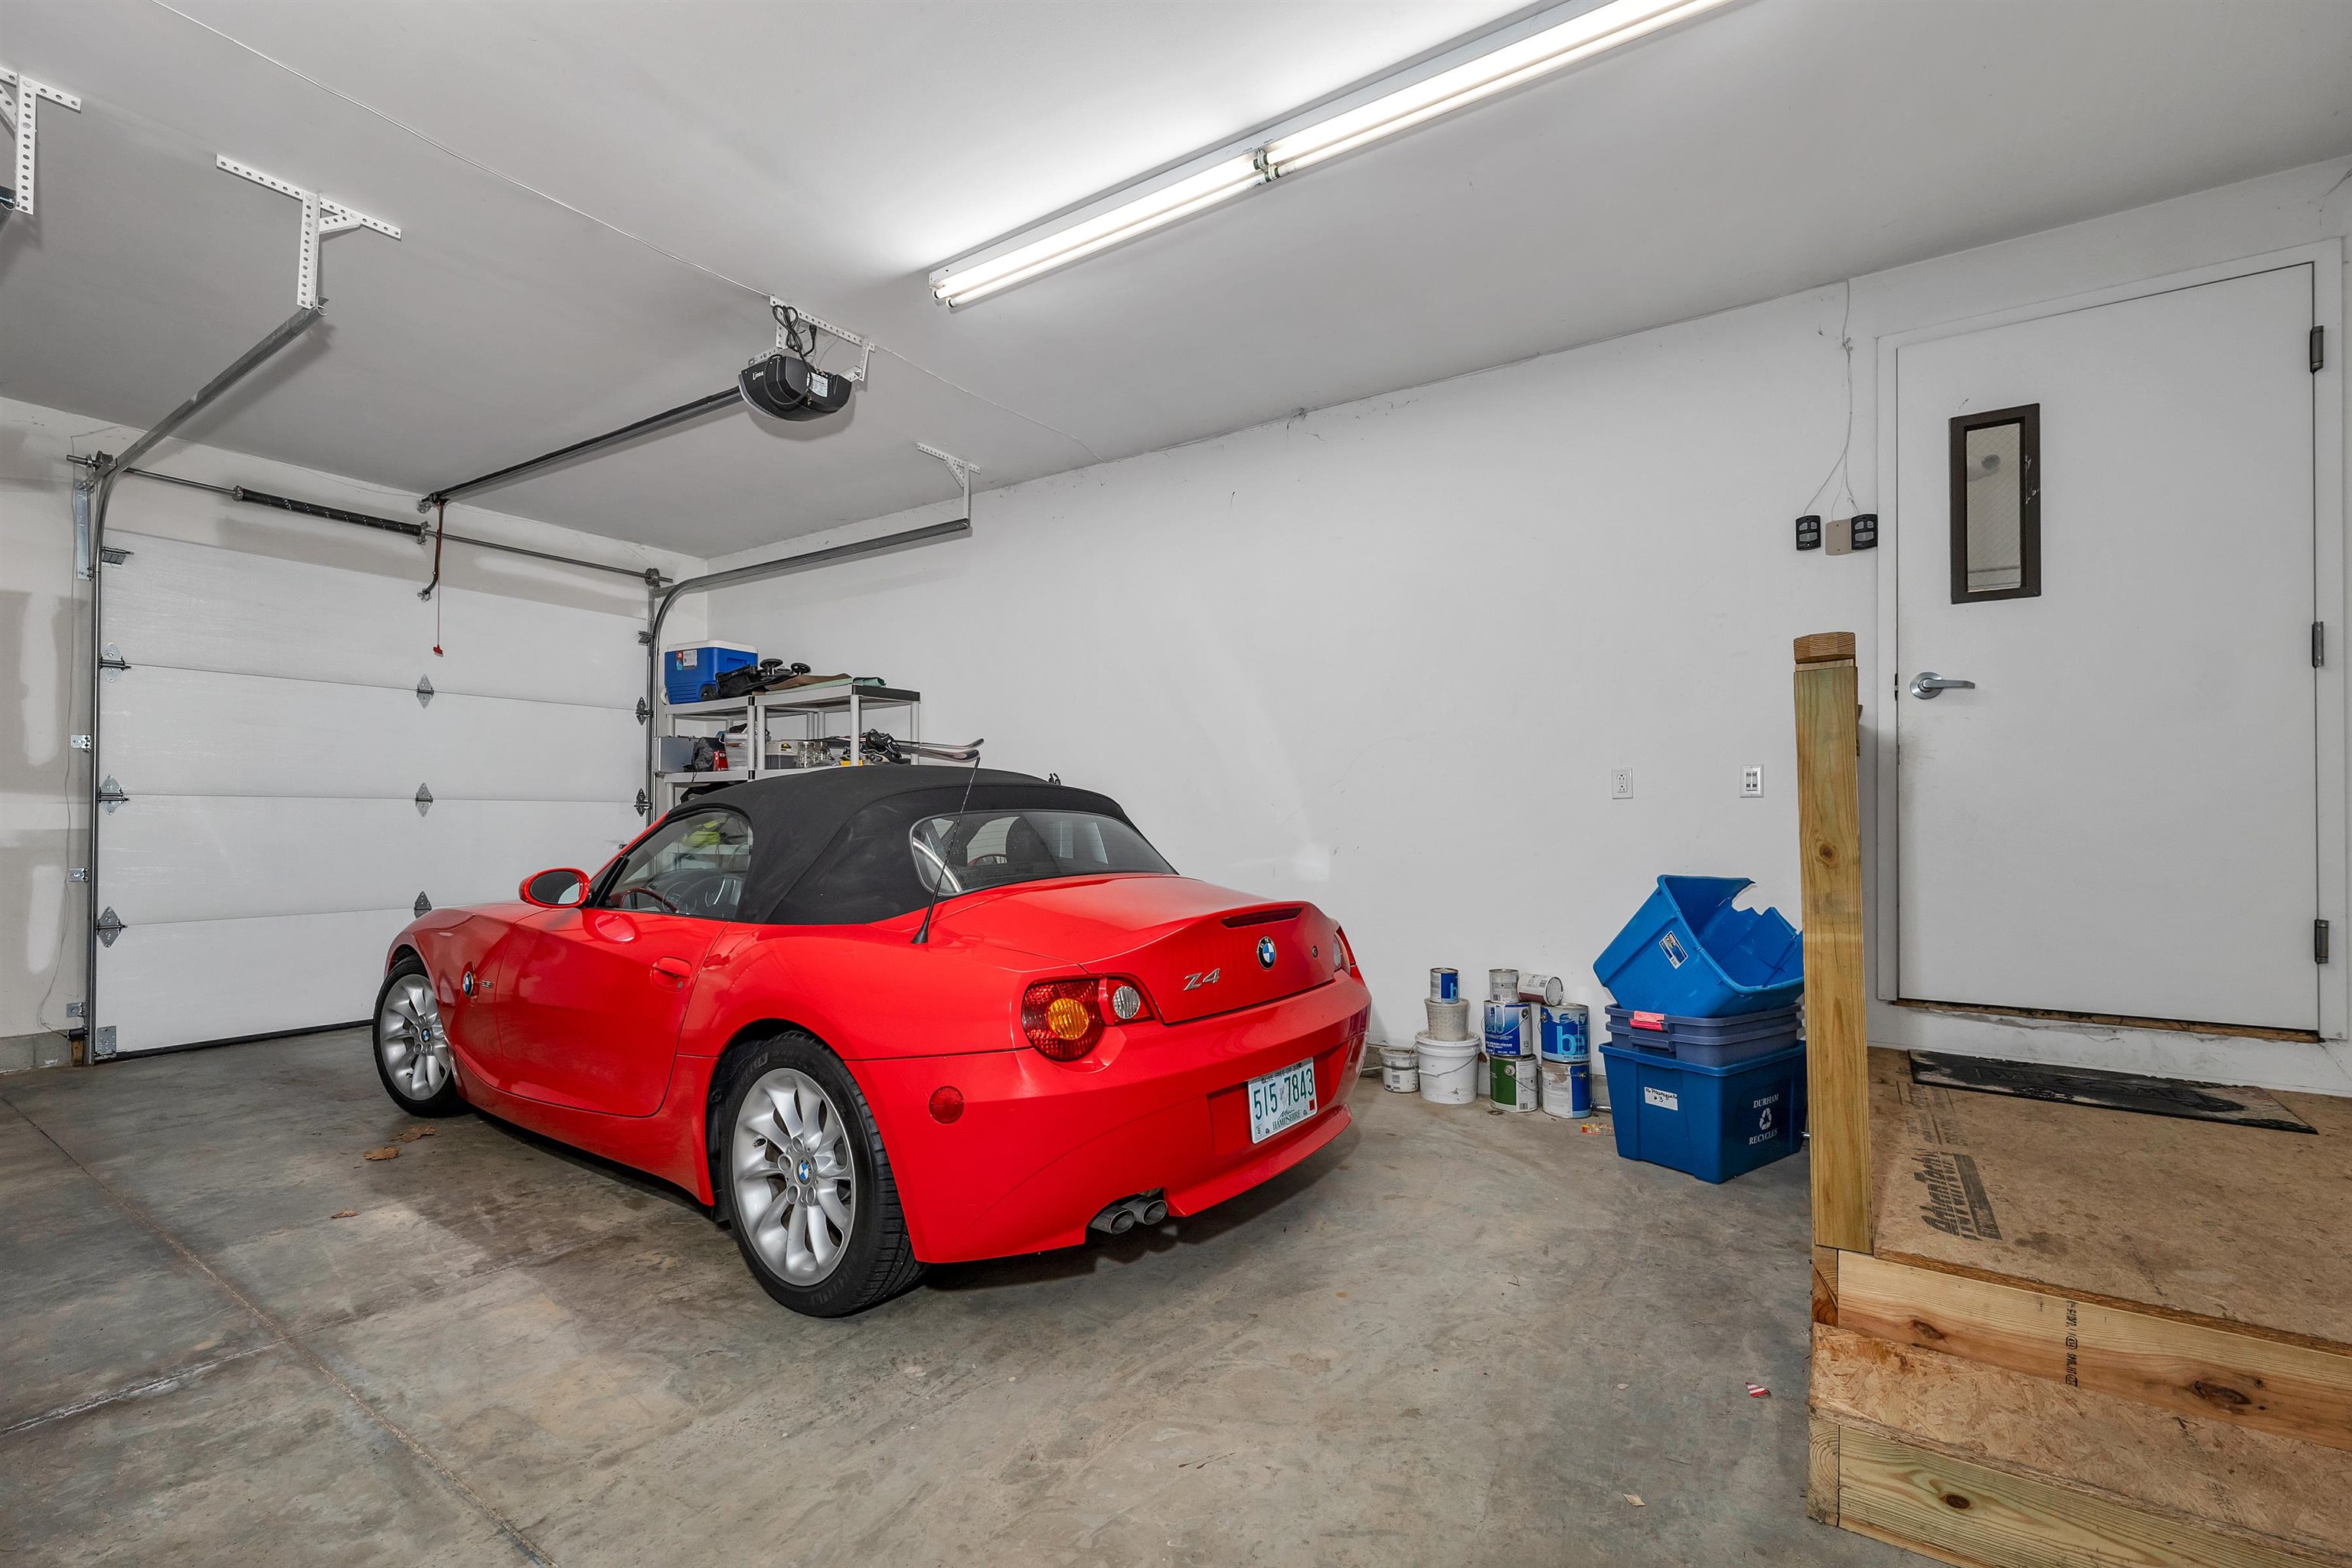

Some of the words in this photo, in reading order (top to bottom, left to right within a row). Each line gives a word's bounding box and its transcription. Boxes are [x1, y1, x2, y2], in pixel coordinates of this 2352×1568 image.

[1184, 968, 1220, 991] Z4
[1275, 1069, 1285, 1078] FREE
[1253, 1083, 1278, 1120] 515
[1284, 1068, 1314, 1106] 7843
[1753, 1093, 1779, 1109] DURHAM
[1272, 1109, 1302, 1131] HAMPSHIRE
[1748, 1128, 1779, 1145] RECYCLES
